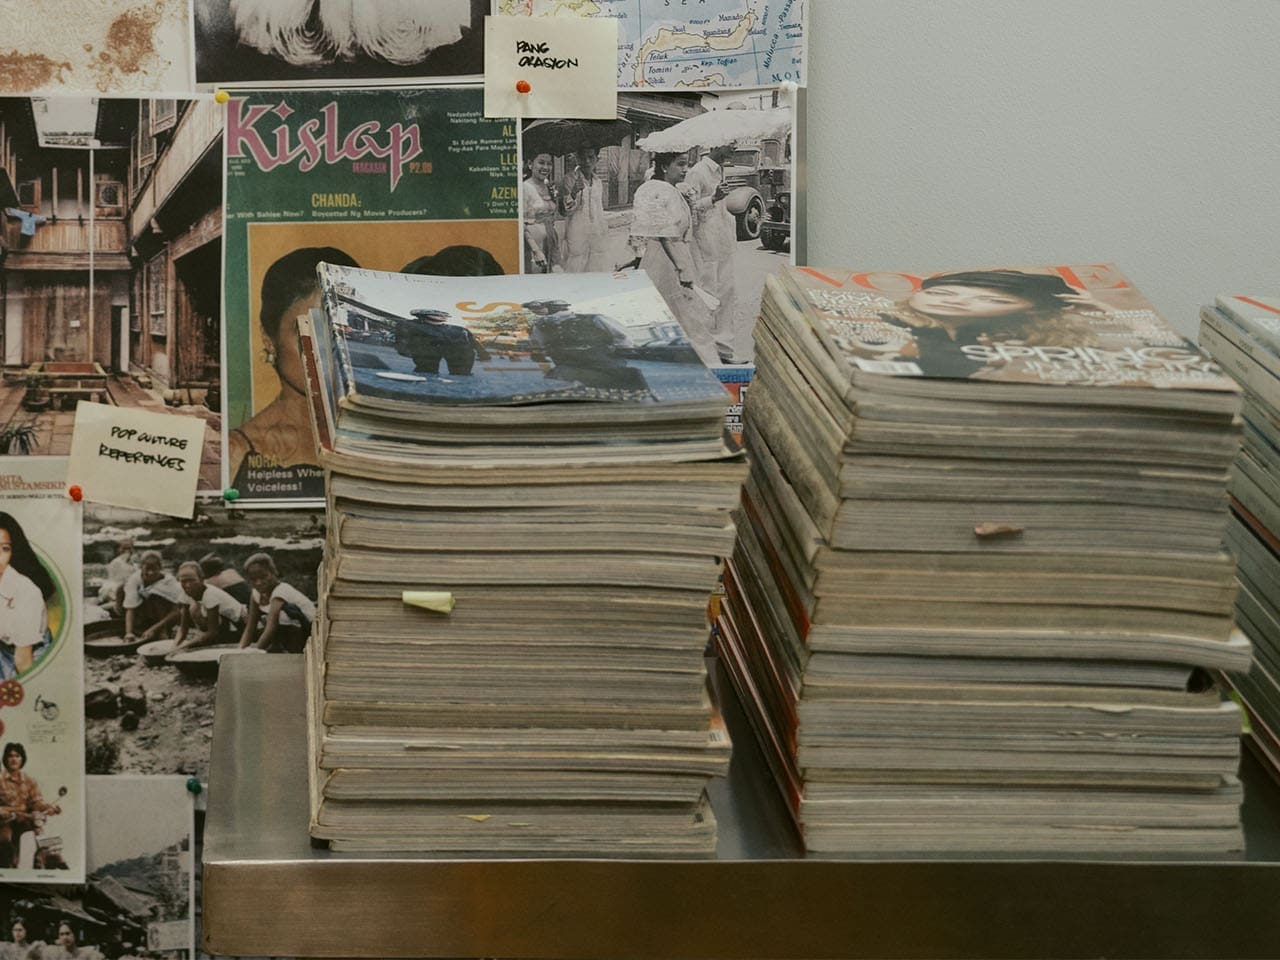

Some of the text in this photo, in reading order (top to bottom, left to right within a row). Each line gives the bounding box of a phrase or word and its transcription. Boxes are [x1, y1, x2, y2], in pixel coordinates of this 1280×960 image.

[516, 41, 551, 55] PANG
[518, 56, 580, 70] ORASYON
[227, 96, 424, 193] Kislap
[311, 210, 349, 220] Boycotted
[363, 209, 386, 218] Movie
[111, 425, 189, 451] POP CULTURE
[247, 469, 294, 480] Helpless
[247, 482, 303, 494] Voiceless!
